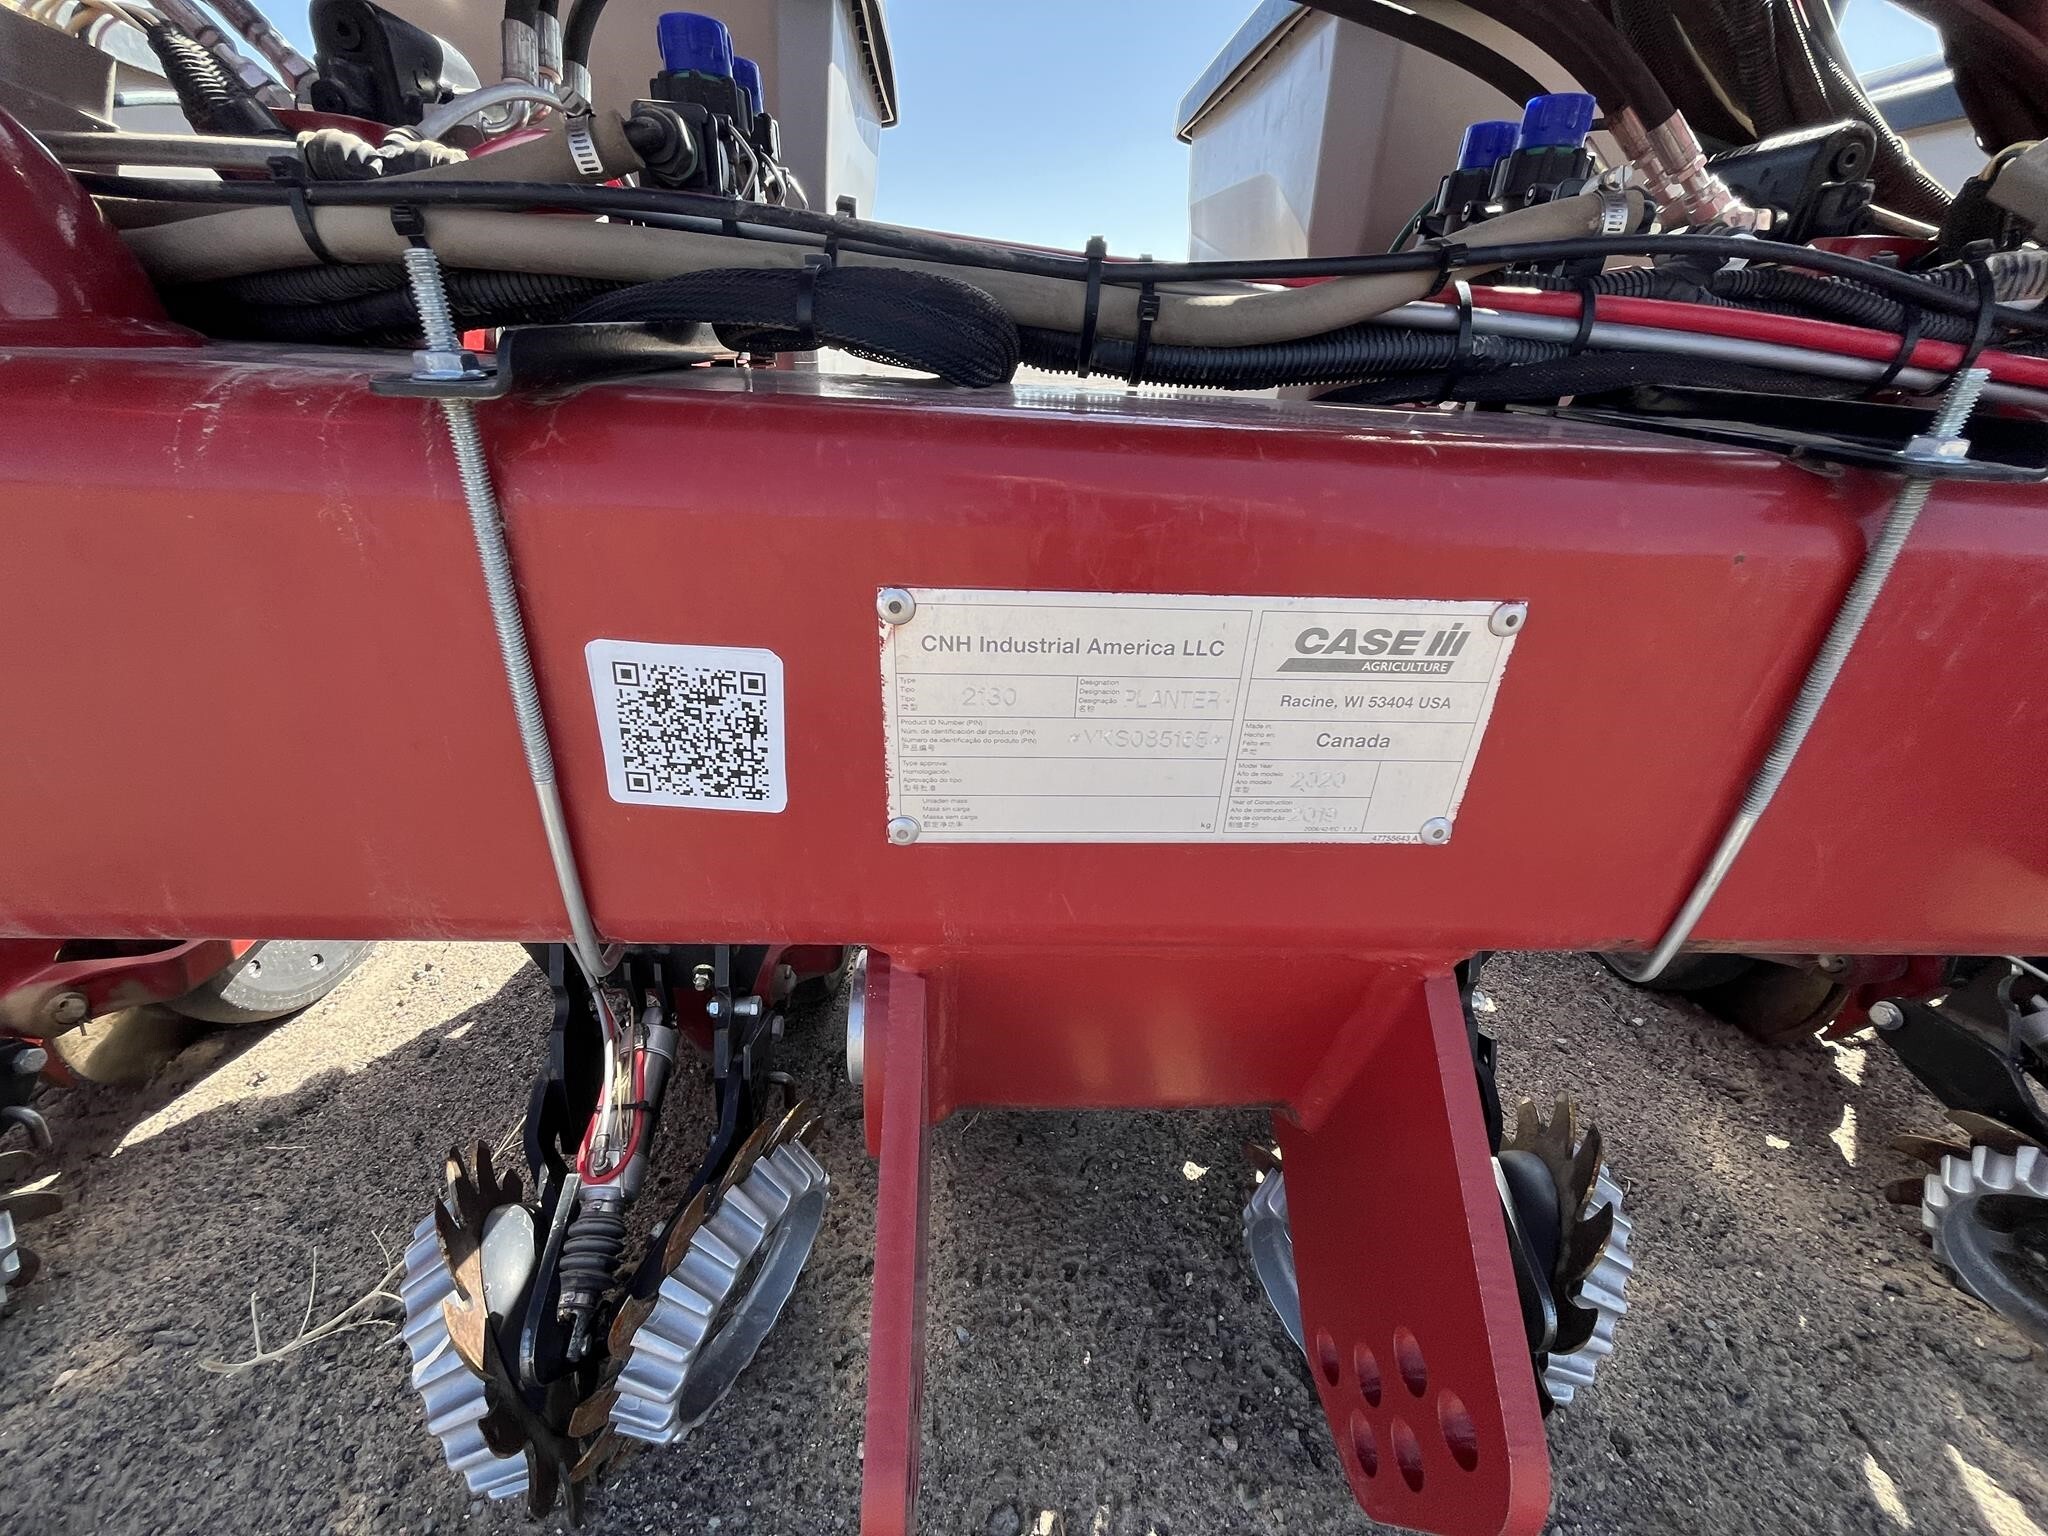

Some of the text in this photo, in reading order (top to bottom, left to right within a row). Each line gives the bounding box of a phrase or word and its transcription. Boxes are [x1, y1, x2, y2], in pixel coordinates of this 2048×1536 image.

[921, 634, 1225, 657] CNH Industrial America LLC
[1294, 627, 1426, 656] CASE
[1361, 661, 1449, 673] AGRICULTURE
[900, 676, 917, 685] Type
[1079, 678, 1120, 687] Designation
[900, 685, 917, 694] Tipo
[900, 694, 917, 703] Tipo
[1124, 688, 1221, 711] PLANTER
[1280, 694, 1452, 710] Racine, WI 53404 USA
[900, 718, 928, 726] Product
[938, 719, 966, 727] Number
[966, 719, 984, 728] (PIN)
[988, 729, 1018, 738] producto
[1019, 729, 1037, 738] (PIN)
[1316, 731, 1392, 750] Canada
[1200, 822, 1212, 832] kg
